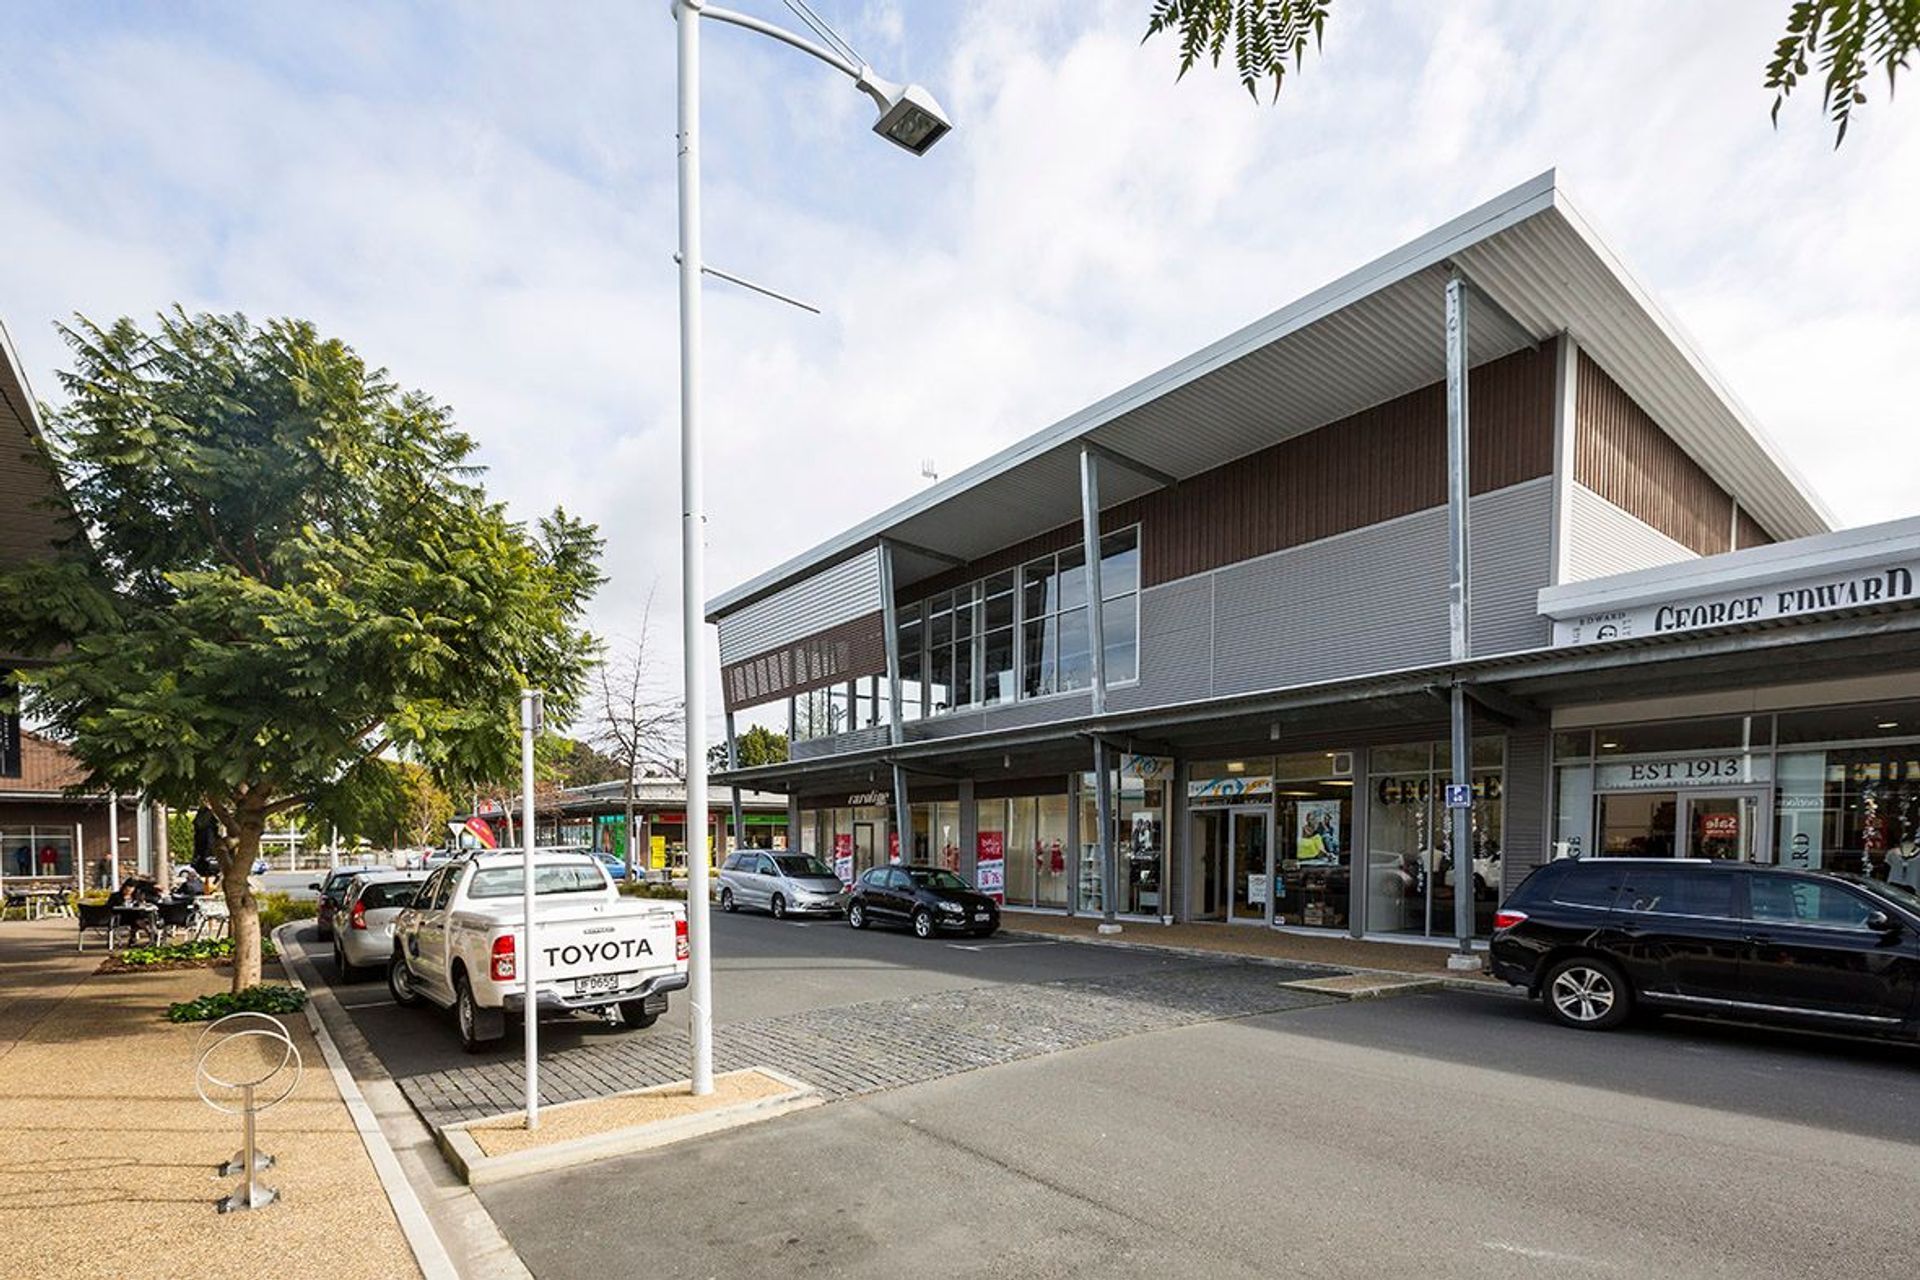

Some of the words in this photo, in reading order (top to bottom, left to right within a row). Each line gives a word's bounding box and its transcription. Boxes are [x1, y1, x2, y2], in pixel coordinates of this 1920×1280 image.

[1654, 597, 1763, 632] GEORGE
[1777, 567, 1913, 614] EDWARD
[1631, 762, 1678, 781] EST
[1687, 758, 1739, 778] 1913
[543, 938, 653, 967] TOYOTA
